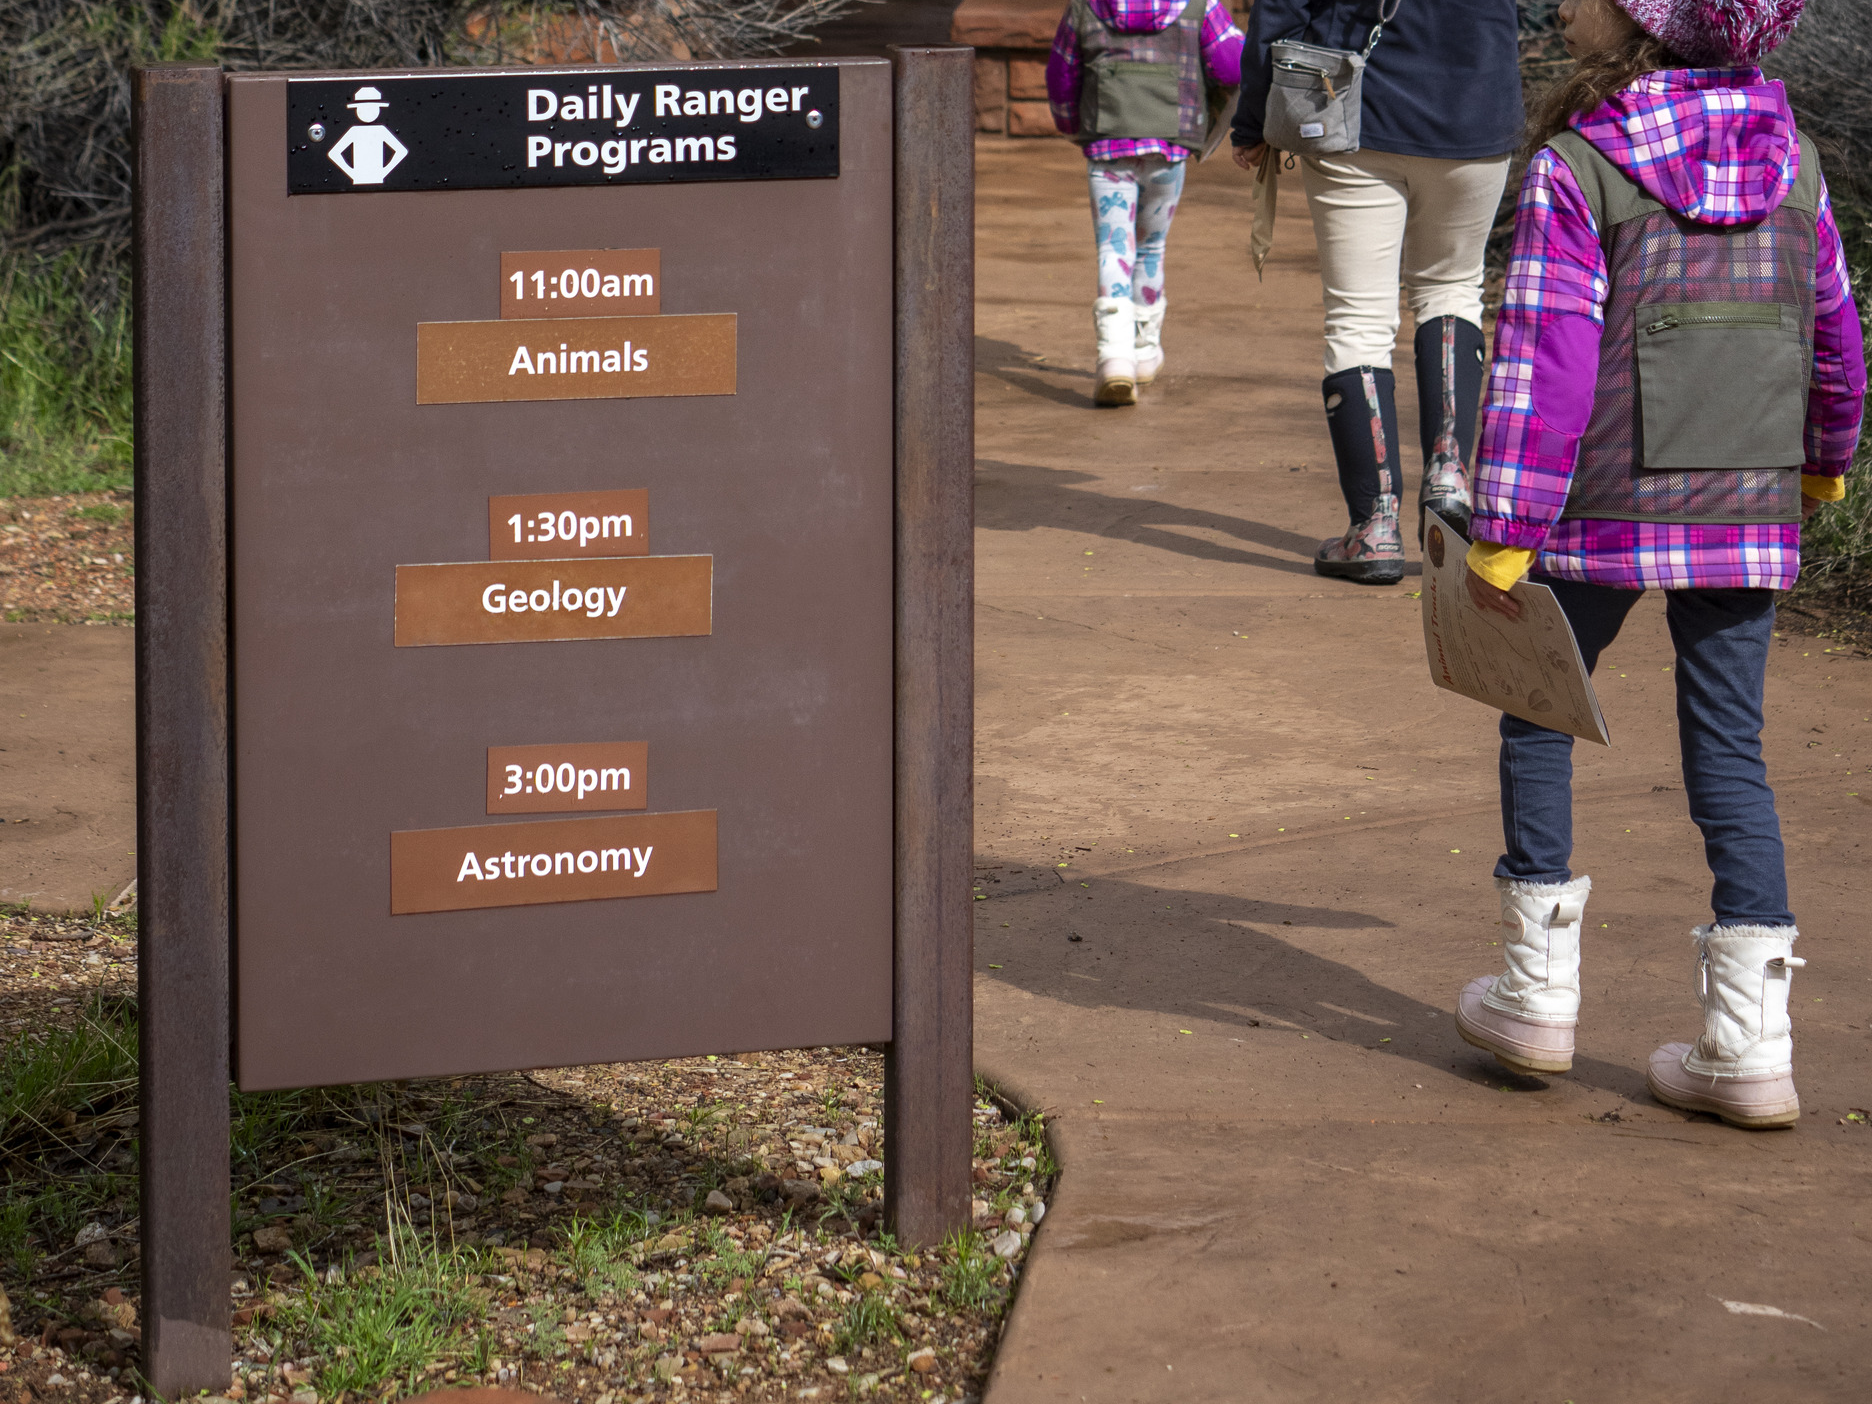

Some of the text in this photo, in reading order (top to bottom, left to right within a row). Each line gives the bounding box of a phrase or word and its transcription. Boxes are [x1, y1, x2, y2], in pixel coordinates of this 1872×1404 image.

[526, 84, 809, 128] Daily Ranger
[526, 134, 736, 174] Programs
[509, 268, 654, 300] 11:00am
[508, 340, 649, 376] Animals
[507, 510, 633, 548] 1:30pm
[482, 579, 627, 619] Geology
[1430, 575, 1454, 686] Animal Tracks
[503, 762, 631, 800] 3:00pm
[456, 846, 654, 882] Astronomy
